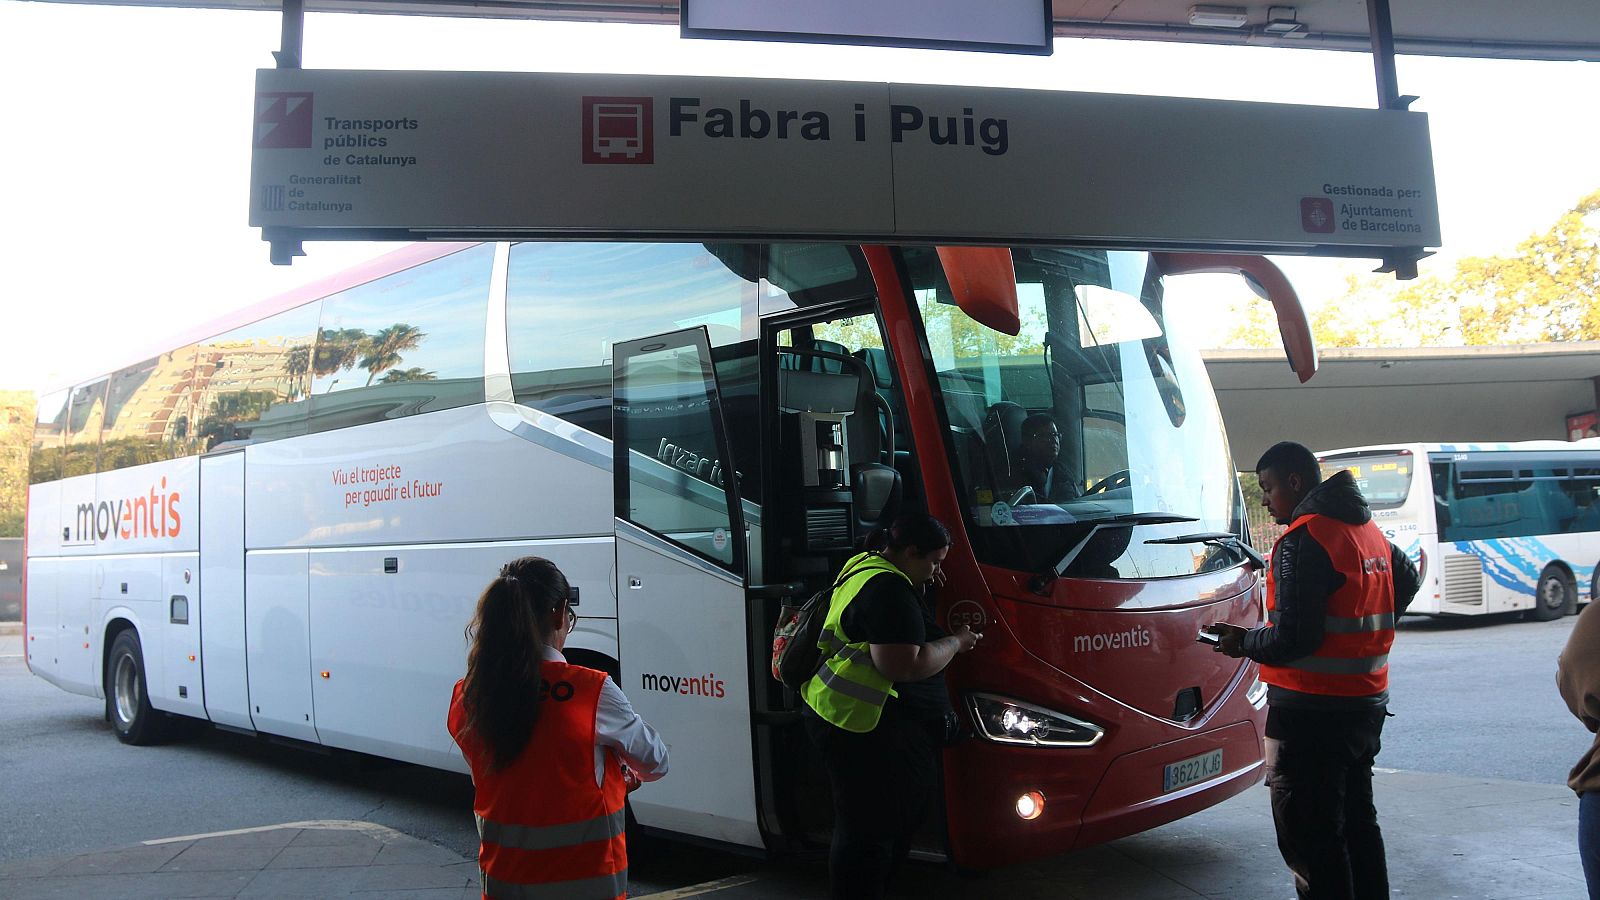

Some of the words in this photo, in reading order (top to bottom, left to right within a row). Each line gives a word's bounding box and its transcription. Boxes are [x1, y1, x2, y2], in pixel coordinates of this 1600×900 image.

[324, 116, 418, 131] Transports
[669, 96, 831, 141] Fabra
[855, 102, 867, 142] i
[891, 104, 1009, 156] Puig
[323, 134, 387, 150] públics
[323, 154, 341, 166] de
[345, 154, 417, 167] Catalunya
[289, 174, 362, 185] Generalitat
[288, 187, 305, 198] de
[1322, 183, 1393, 197] Gestionada
[1397, 189, 1421, 199] per:
[288, 201, 352, 213] Catalunya
[1340, 203, 1413, 218] Ajuntament
[1342, 219, 1357, 231] de
[1361, 219, 1421, 233] Barcelona
[657, 437, 709, 475] Irizar
[332, 469, 347, 486] Viu
[350, 466, 360, 484] el
[361, 463, 401, 486] trajecte
[345, 491, 362, 509] per
[363, 482, 399, 507] gaudir
[400, 481, 411, 499] el
[413, 480, 443, 498] futur
[76, 476, 181, 541] moventis
[951, 611, 982, 626] 259
[1073, 624, 1150, 653] moventis
[642, 672, 725, 698] moventis
[1172, 760, 1200, 786] 3622
[1202, 753, 1221, 776] KJG
